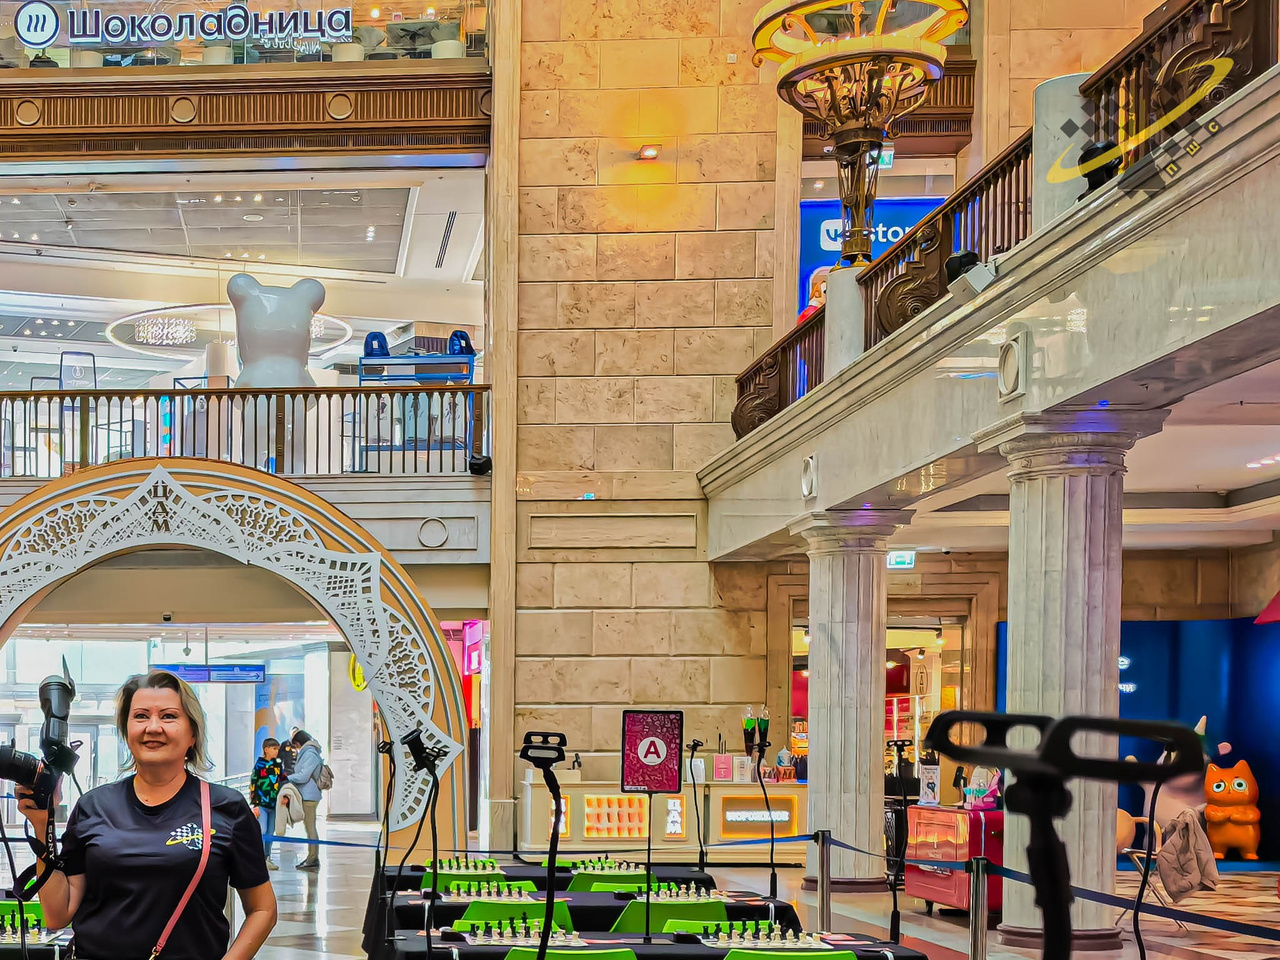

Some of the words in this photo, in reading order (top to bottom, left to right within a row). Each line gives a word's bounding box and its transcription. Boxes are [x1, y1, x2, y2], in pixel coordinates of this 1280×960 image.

[67, 4, 353, 43] Шоколадница
[643, 740, 662, 759] A
[47, 825, 55, 860] SONY
